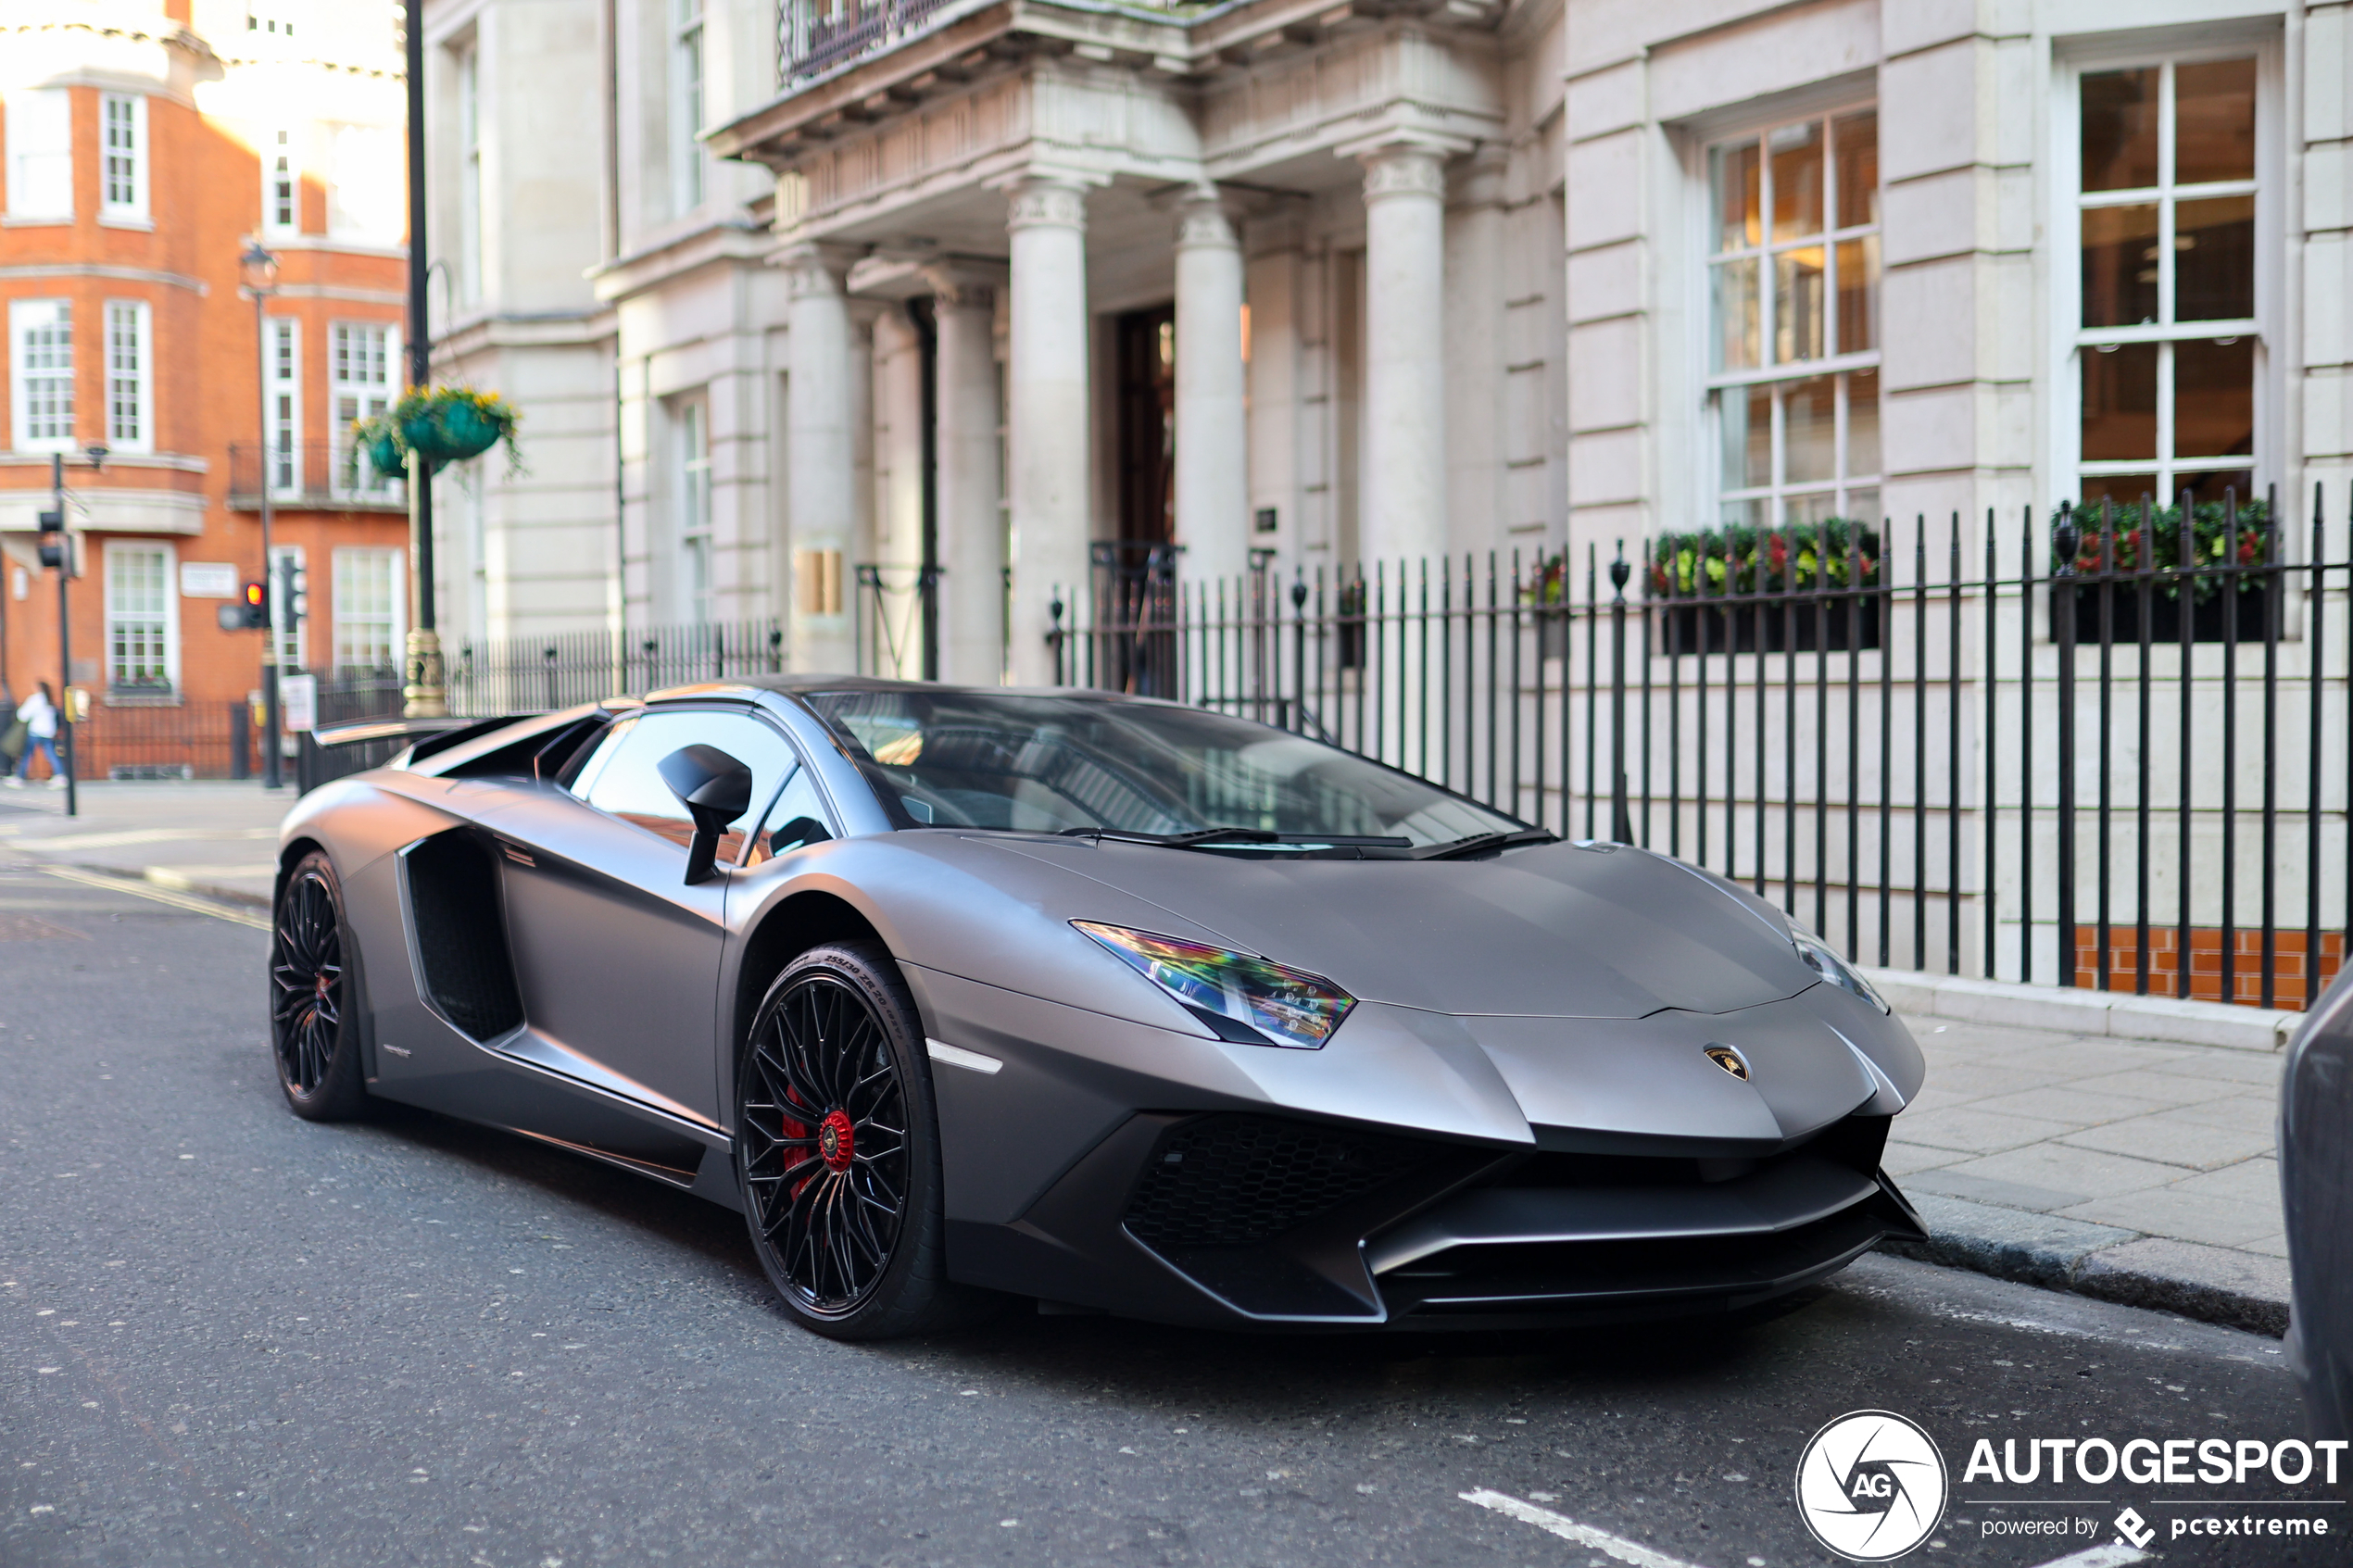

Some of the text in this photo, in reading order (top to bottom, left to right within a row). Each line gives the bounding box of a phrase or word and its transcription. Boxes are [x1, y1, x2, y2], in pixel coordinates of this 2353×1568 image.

[824, 955, 861, 974] 255/30
[859, 973, 876, 990] ZR
[872, 989, 887, 1007] 20
